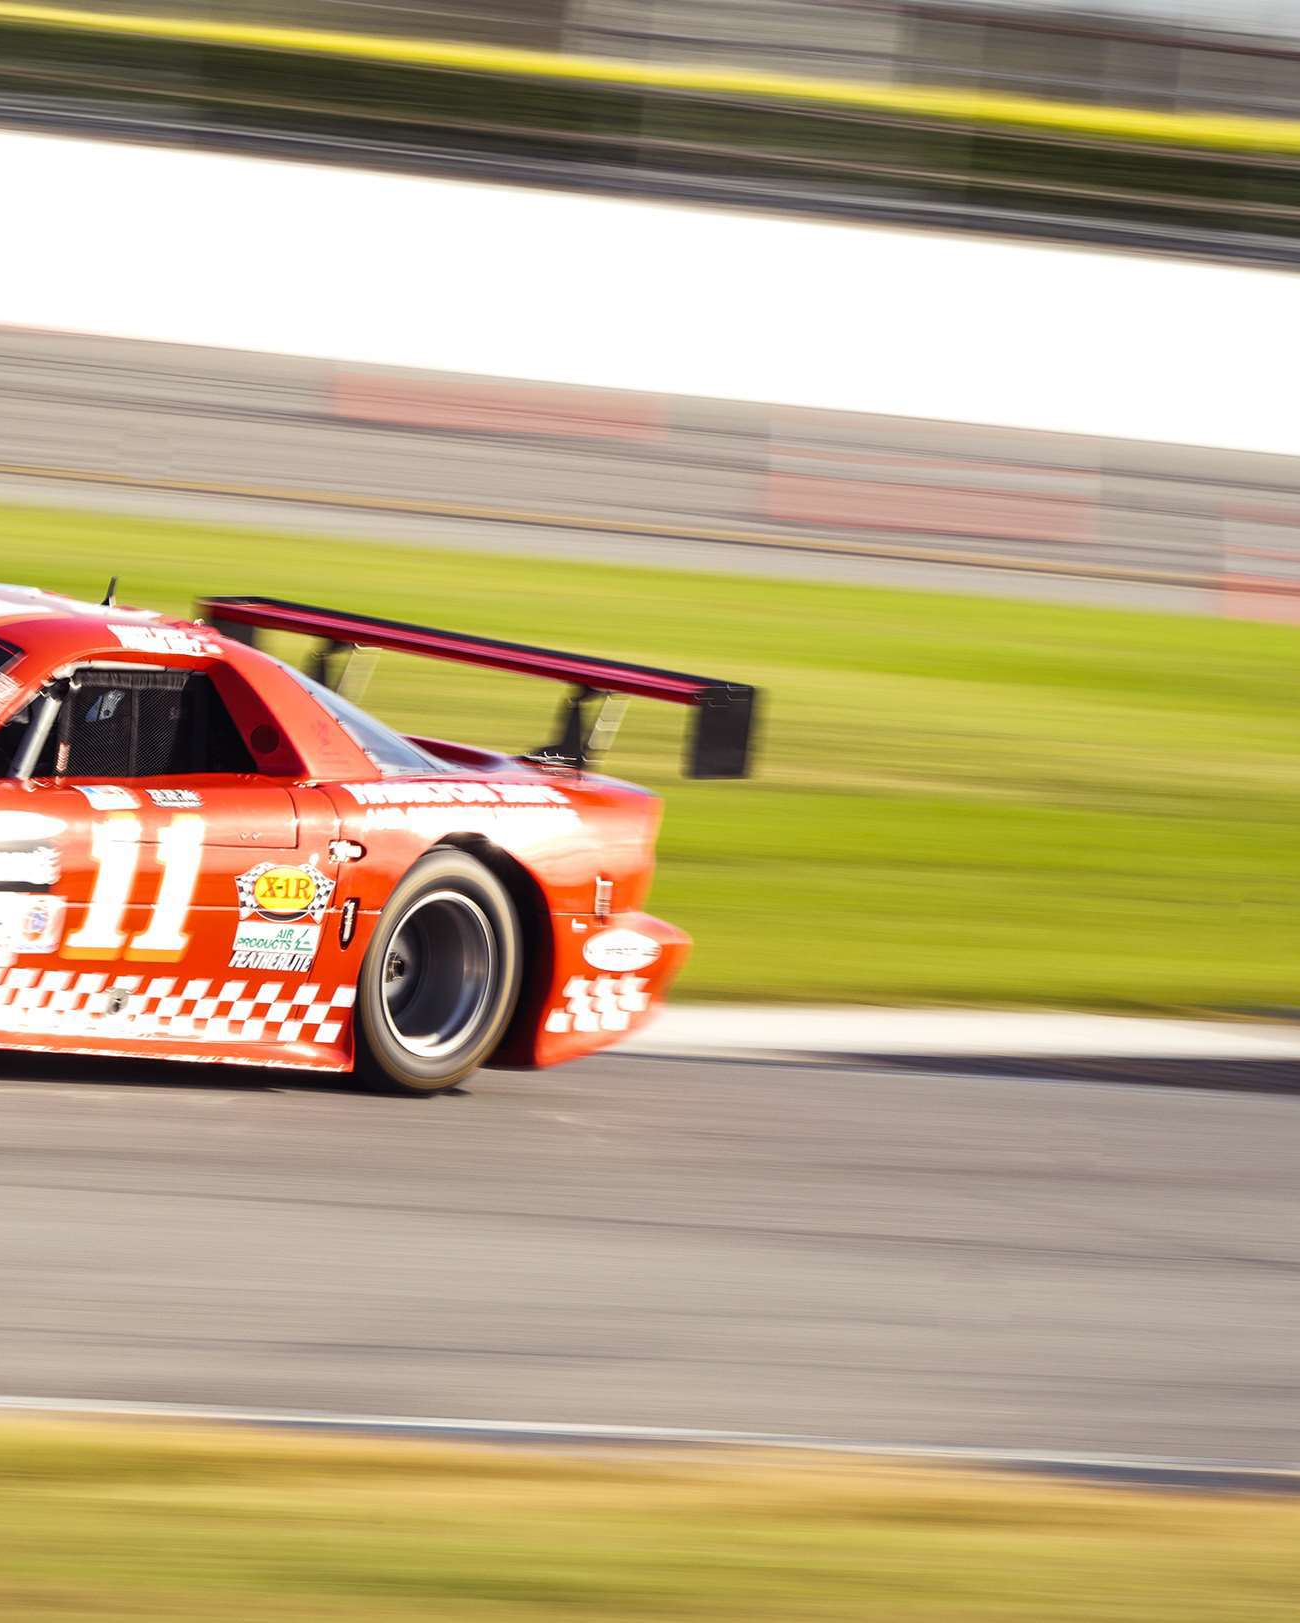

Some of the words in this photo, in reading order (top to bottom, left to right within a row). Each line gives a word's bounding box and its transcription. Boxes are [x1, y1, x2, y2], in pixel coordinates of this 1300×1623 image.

[59, 812, 205, 962] 11
[260, 876, 312, 900] X-1R
[236, 937, 292, 951] PRODUCTS
[275, 928, 295, 939] AIR
[228, 949, 314, 973] FEATHERLITE
